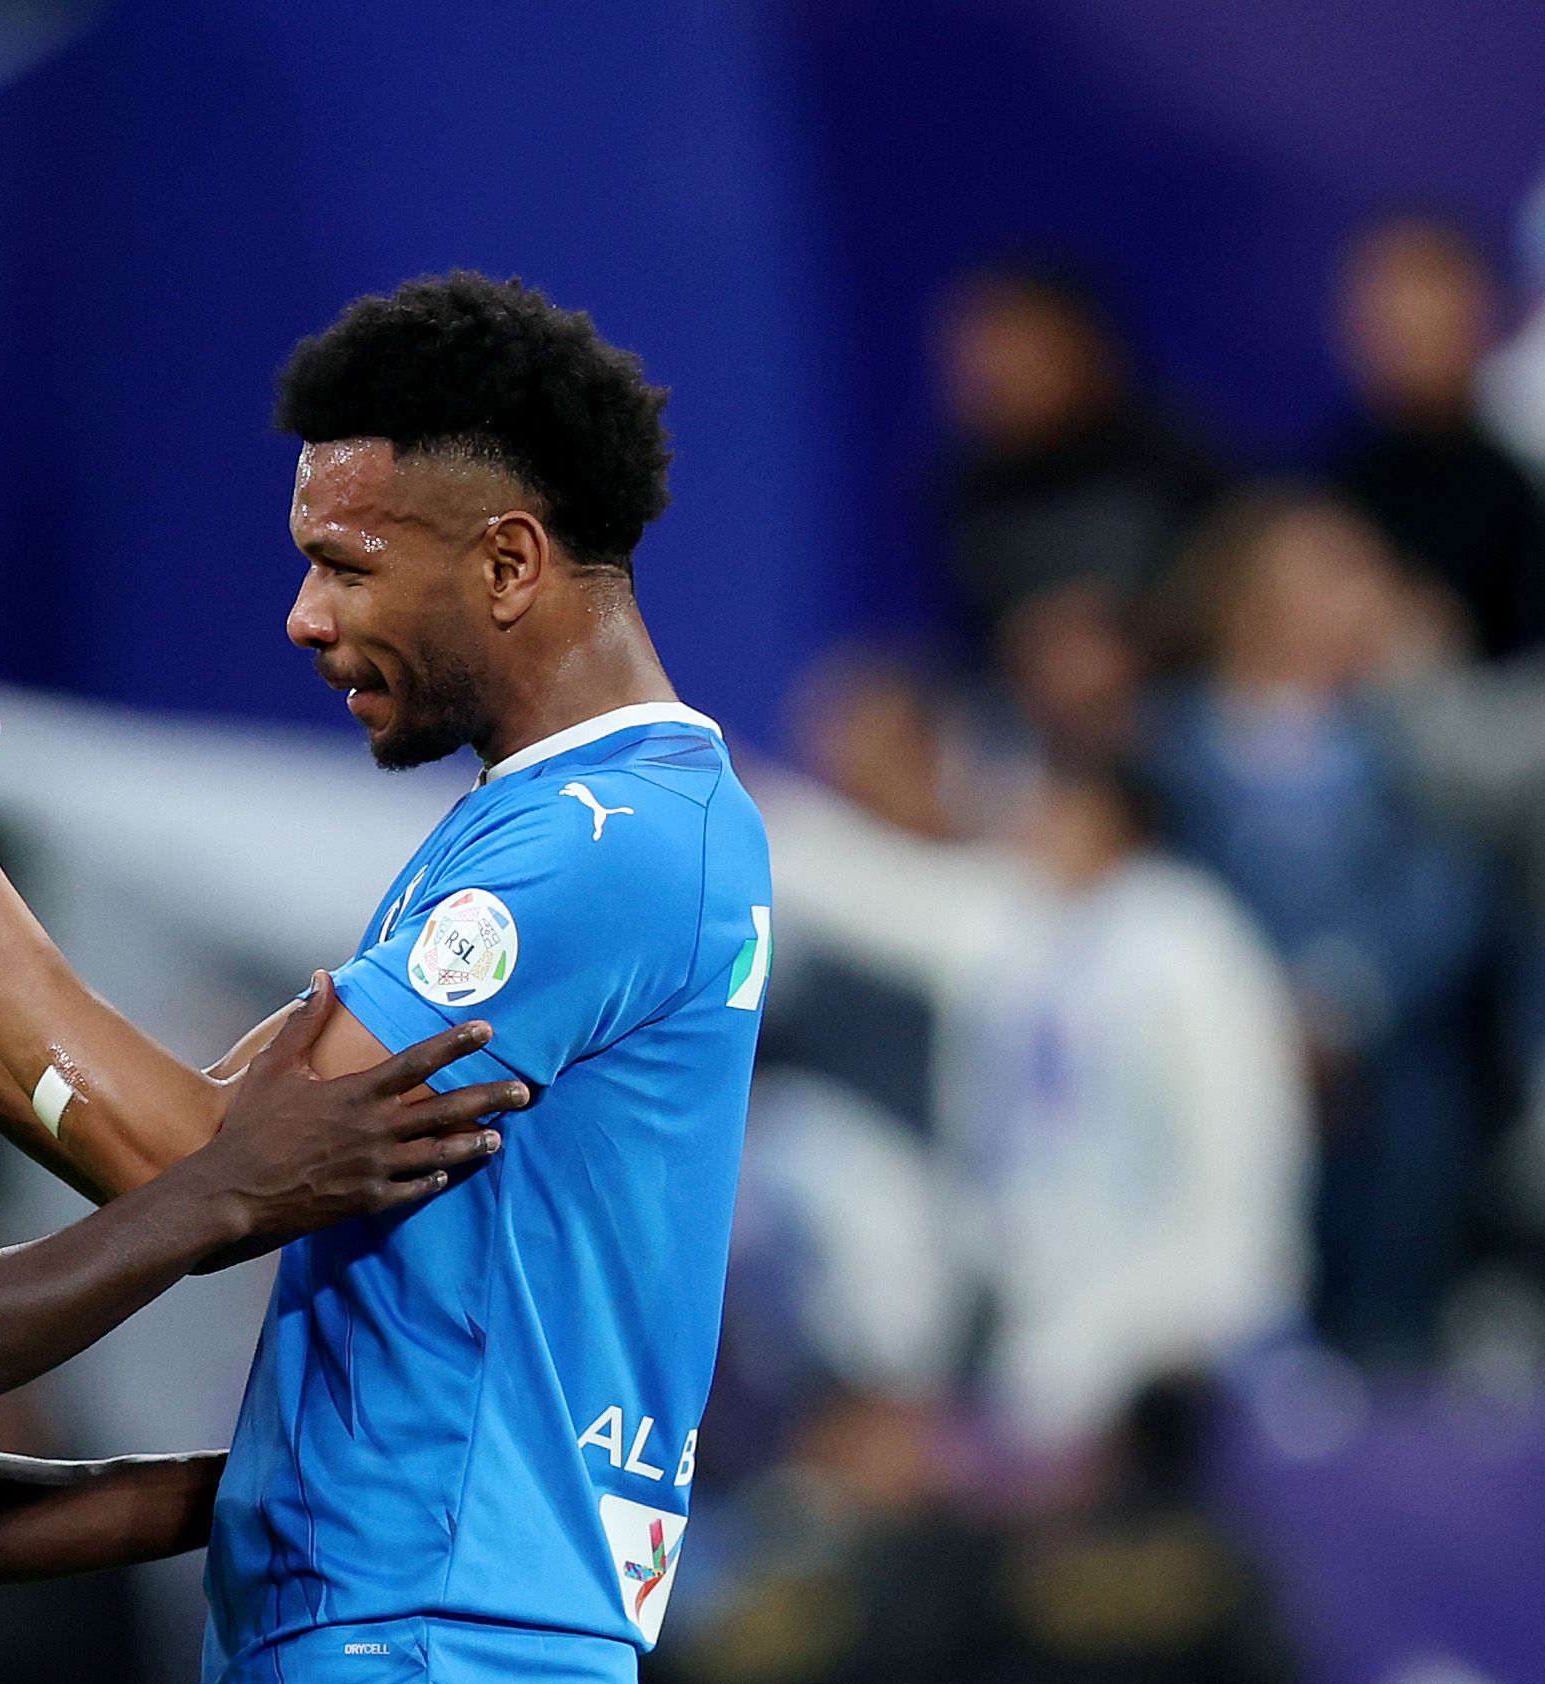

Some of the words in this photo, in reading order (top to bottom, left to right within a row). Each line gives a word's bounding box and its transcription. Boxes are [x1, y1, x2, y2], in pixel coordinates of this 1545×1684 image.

[444, 930, 475, 965] RSL
[577, 1405, 664, 1481] AL
[344, 1643, 390, 1655] DRYCELL
